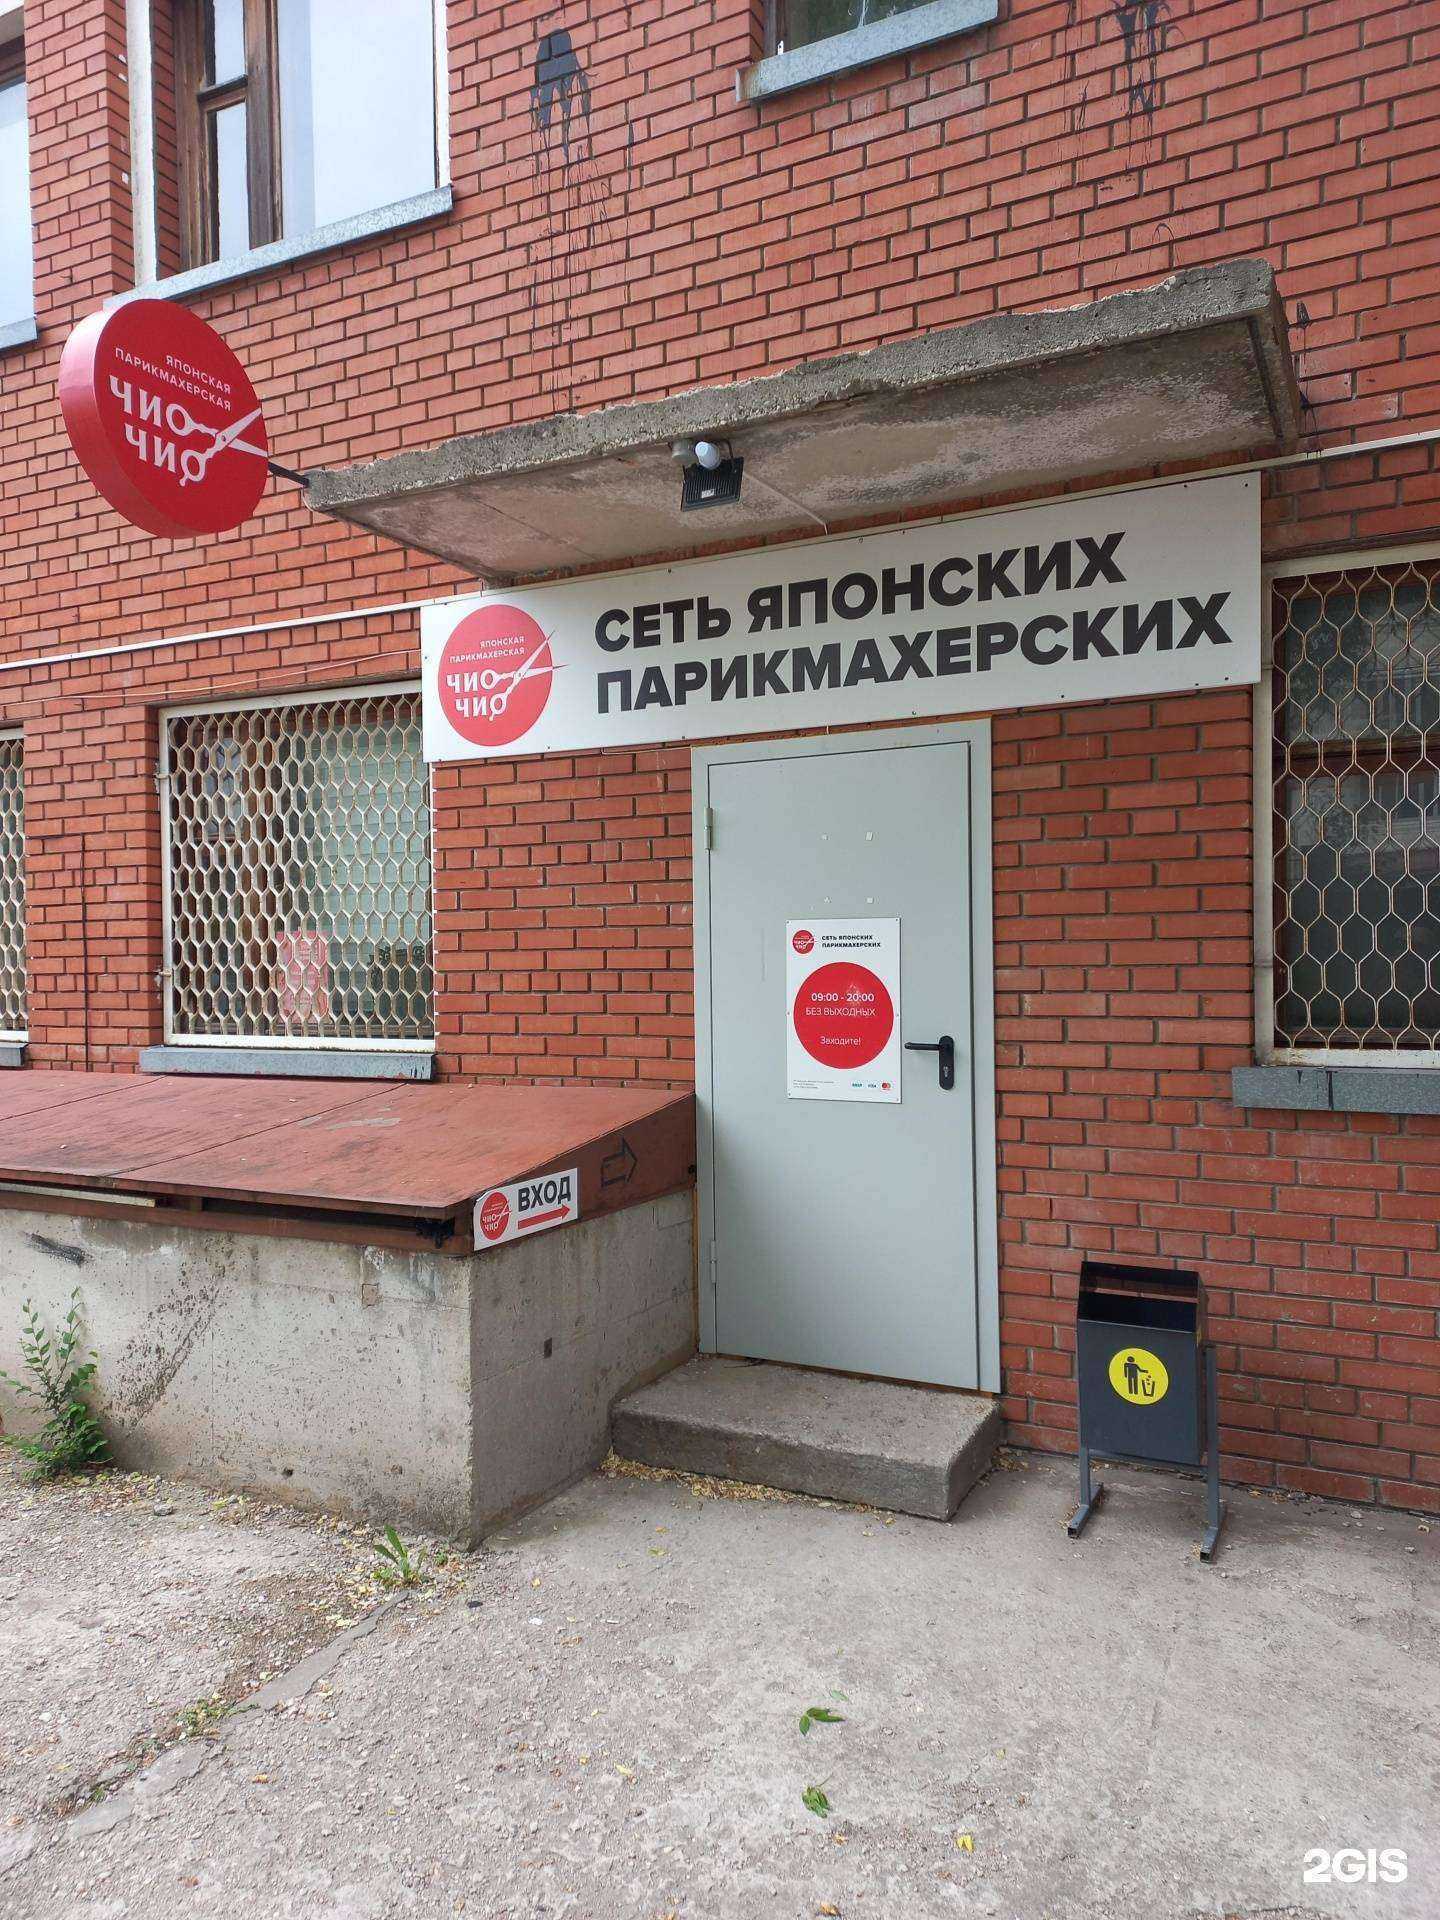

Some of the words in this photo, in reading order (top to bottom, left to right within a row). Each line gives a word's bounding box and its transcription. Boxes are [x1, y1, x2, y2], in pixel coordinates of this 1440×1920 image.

[115, 346, 232, 412] ПАРИКМАХЕРСКАЯ
[166, 354, 232, 395] ЯПОНСКАЯ
[109, 374, 193, 437] ЧИО
[124, 422, 206, 484] ЧИО
[594, 596, 732, 652] СЕТЬ
[747, 531, 1127, 634] ЯПОНСКИХ
[449, 647, 525, 664] ПАРИКМАХЕРСКАЯ
[480, 636, 525, 649] ЯПОНСКАЯ
[597, 591, 1233, 714] ПАРИКМАХЕРСКИХ
[446, 669, 497, 693] ЧИО
[455, 693, 507, 720] ЧИО
[805, 1007, 822, 1016] БЕЗ
[824, 1007, 876, 1017] ВЫХОДНЫХ
[811, 993, 838, 1001] 09:00
[846, 993, 875, 1002] 20:00
[820, 1036, 861, 1046] Заходите!
[517, 1175, 572, 1212] ВХОД
